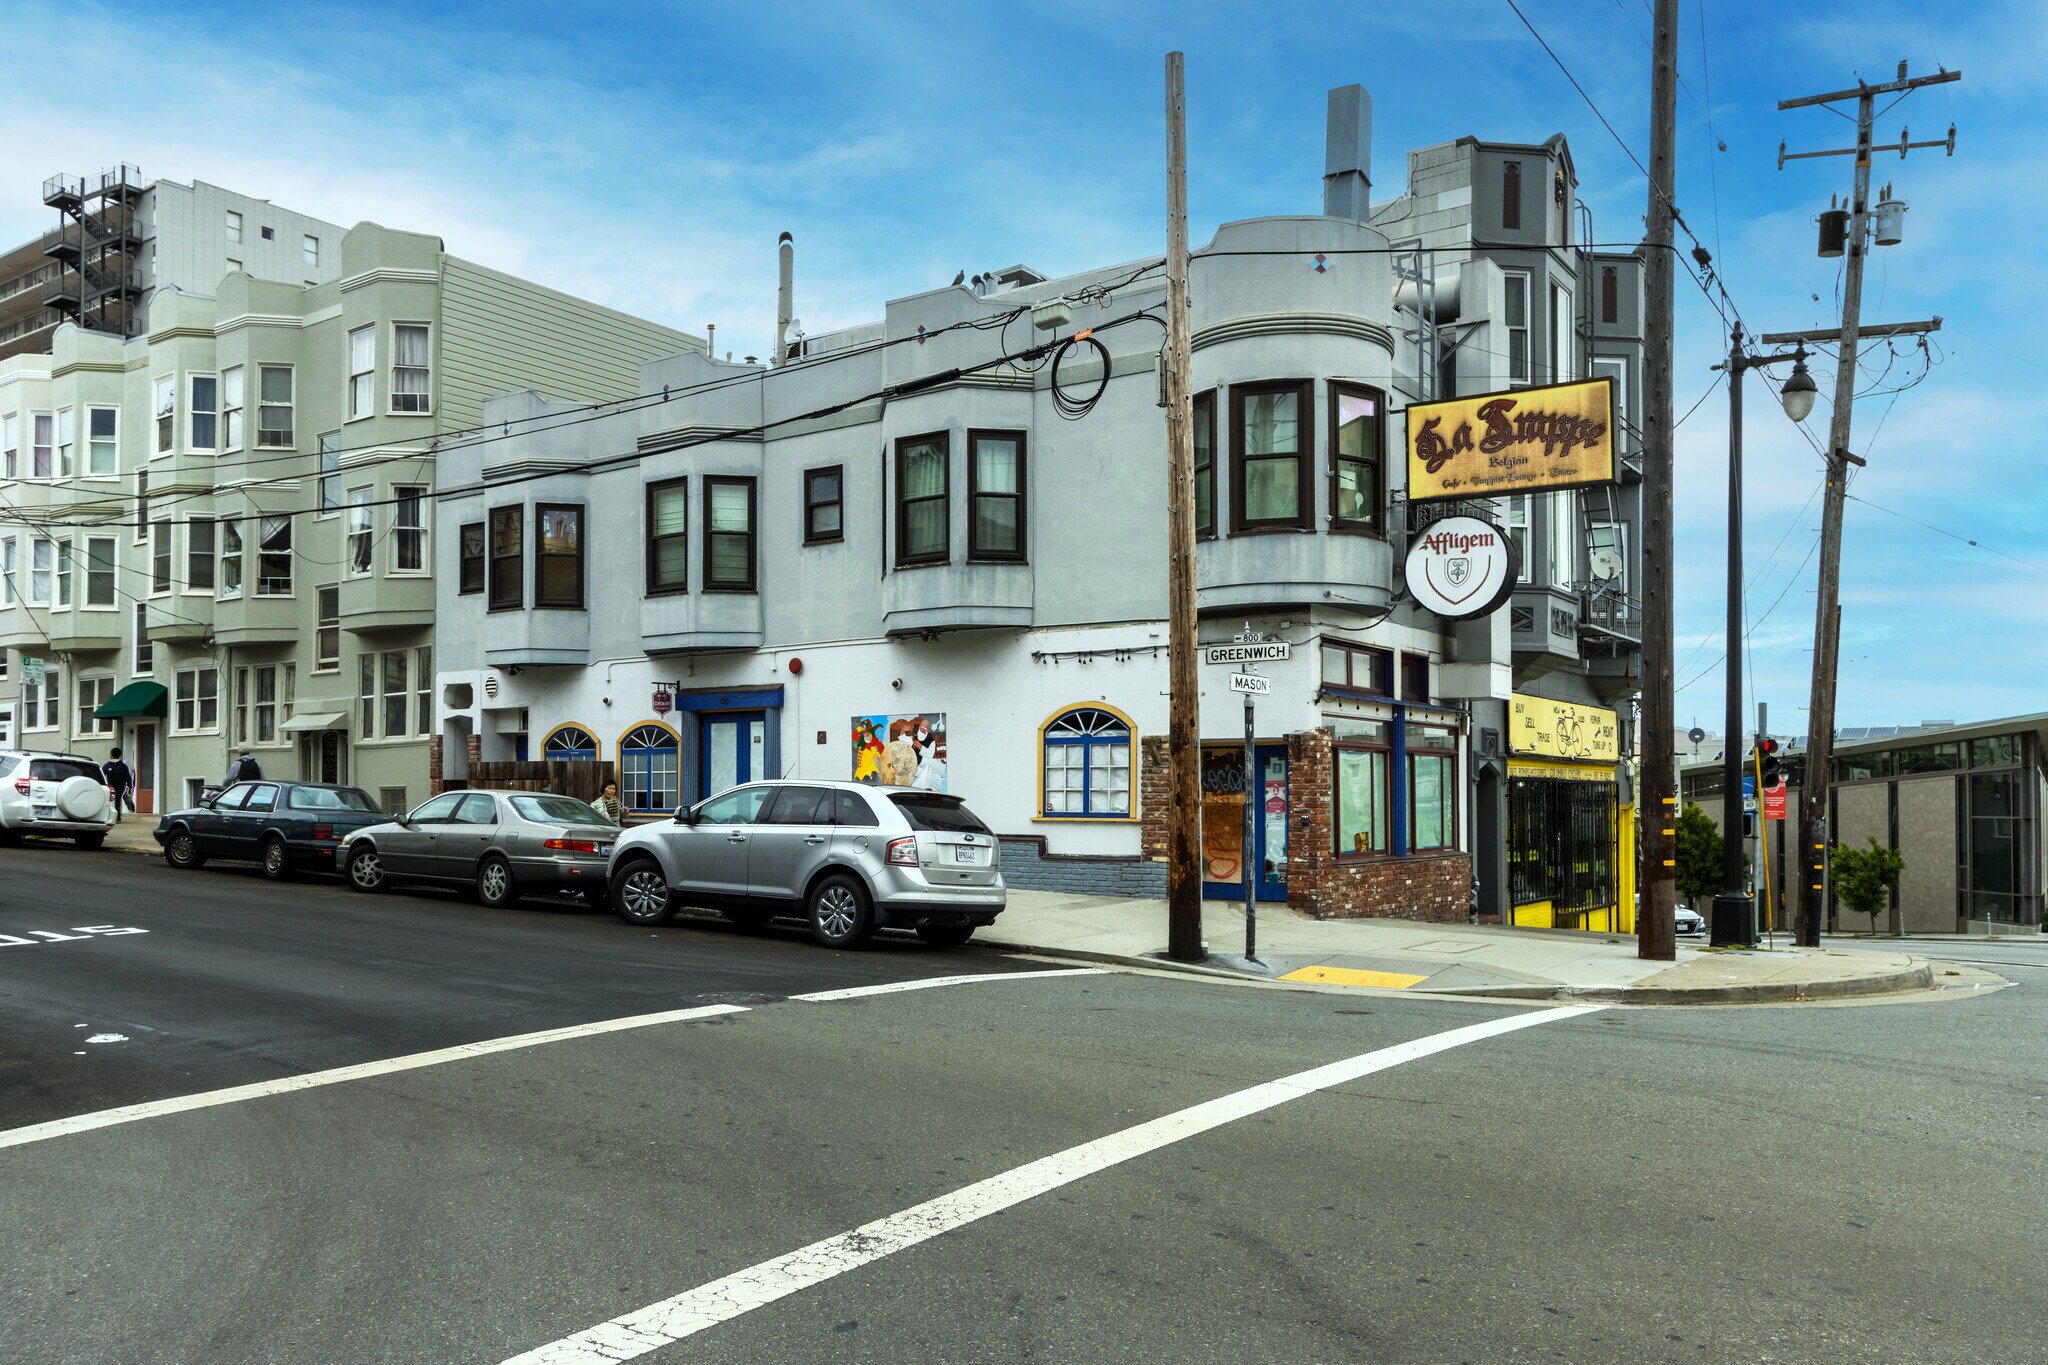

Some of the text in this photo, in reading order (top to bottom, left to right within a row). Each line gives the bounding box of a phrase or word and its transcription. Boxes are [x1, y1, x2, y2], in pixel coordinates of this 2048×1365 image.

[1415, 398, 1606, 474] La Trappe
[1489, 457, 1529, 469] Belgian
[1548, 467, 1578, 477] Bistro
[1419, 532, 1494, 555] Affligem
[1243, 634, 1259, 642] 800
[1211, 646, 1286, 661] GREENWICH
[1235, 676, 1267, 691] MASON
[1515, 703, 1525, 713] BUY
[1525, 716, 1535, 729] SELL
[1537, 731, 1550, 743] TRADE
[1603, 725, 1614, 738] RENT
